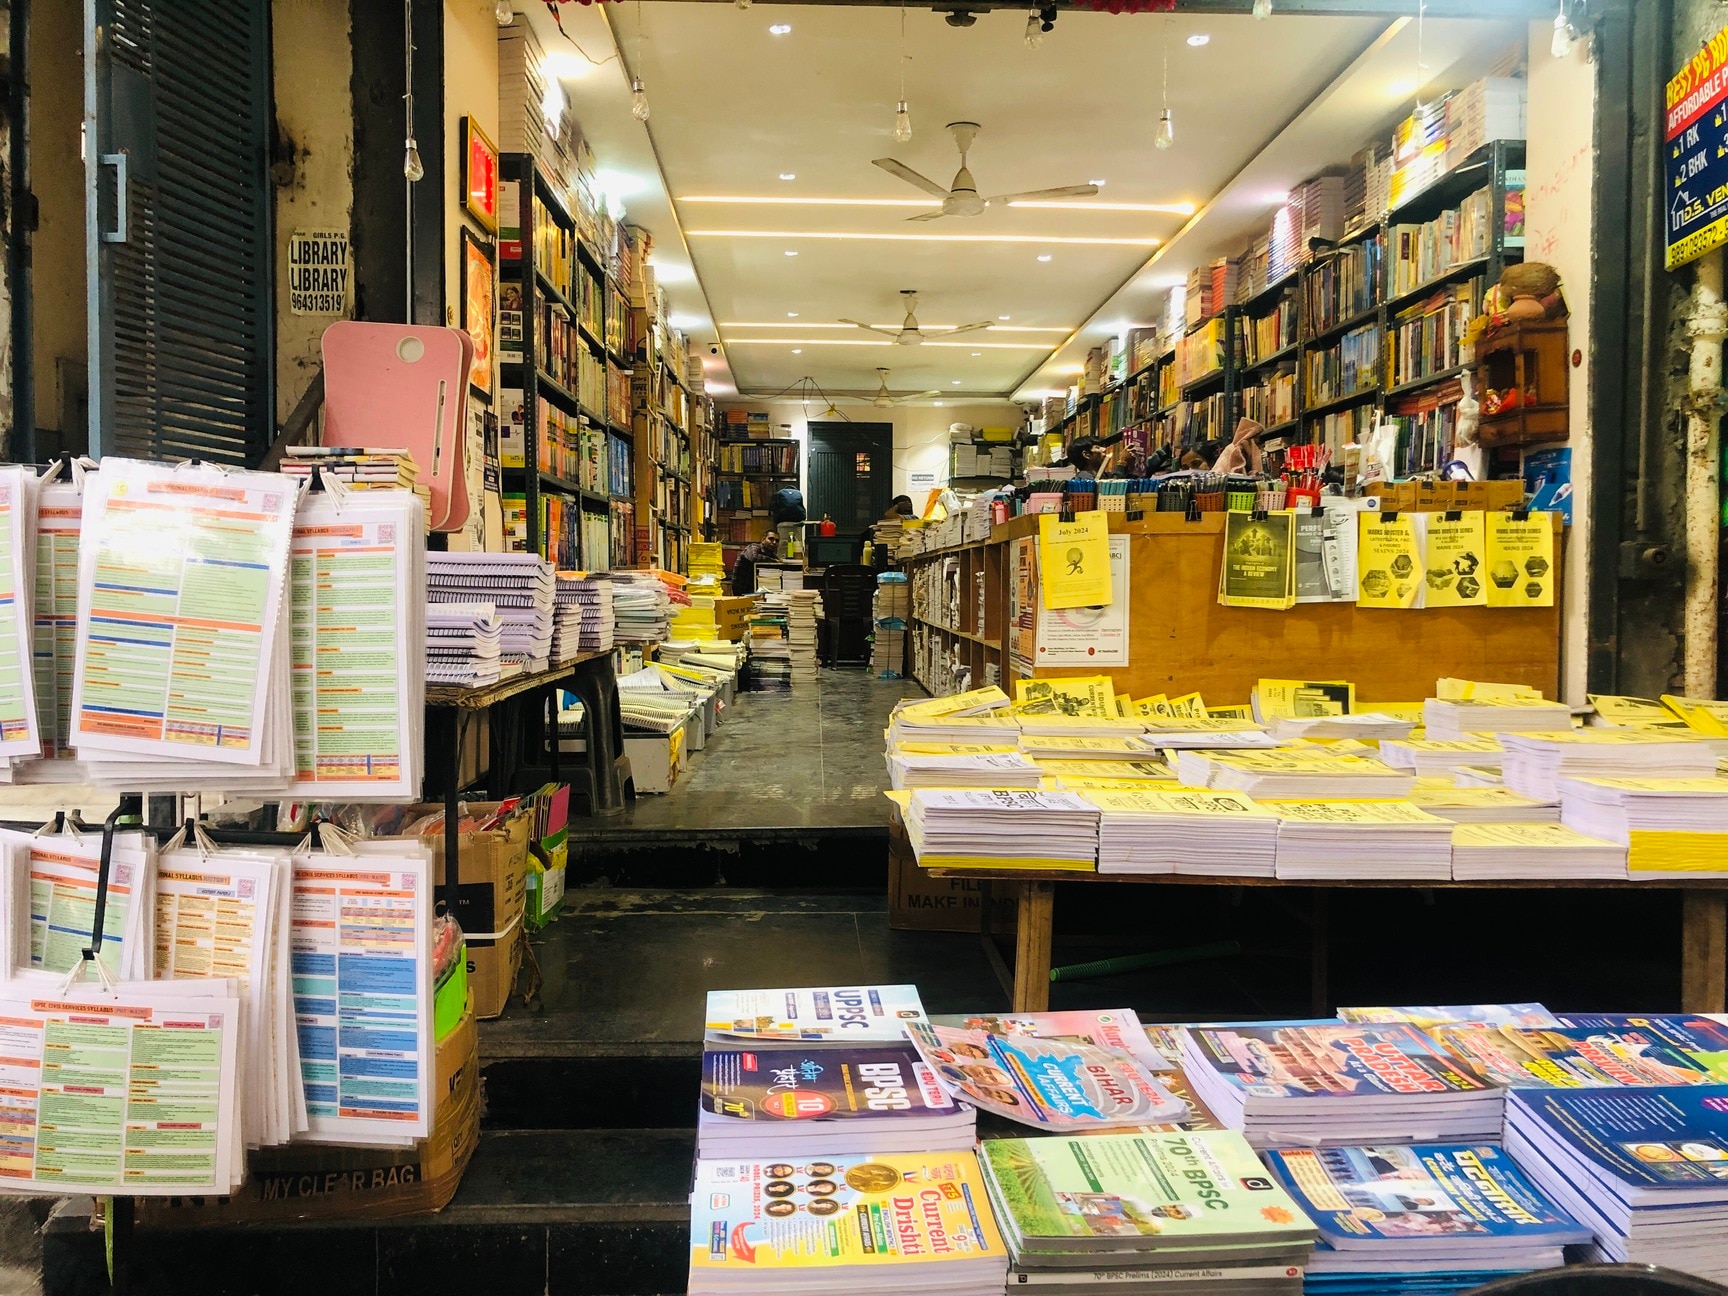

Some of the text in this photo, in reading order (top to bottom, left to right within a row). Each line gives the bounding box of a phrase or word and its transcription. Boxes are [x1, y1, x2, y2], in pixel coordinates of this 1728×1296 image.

[1666, 64, 1692, 110] BEST
[1692, 48, 1710, 87] PG
[1668, 72, 1721, 131] AFFORDABLE
[1686, 123, 1700, 149] RK
[1680, 148, 1708, 183] 2 BHK
[1705, 182, 1728, 206] VEN
[290, 240, 348, 265] LIBRARY
[290, 267, 347, 292] LIBRARY
[175, 873, 203, 881] SYLLABUS
[908, 894, 980, 908] MAKE IN
[833, 989, 870, 1029] UPPSC
[1341, 1038, 1421, 1093] PRADESH
[1374, 1042, 1447, 1093] UTTAR
[1571, 1041, 1645, 1085] PREVIEW
[795, 1096, 825, 1112] 10
[856, 1062, 911, 1112] BPSC
[921, 1071, 945, 1107] EDU TERIA
[1037, 1074, 1073, 1114] AFFAIRS
[1042, 1062, 1088, 1106] CURRENT
[1086, 1065, 1134, 1106] BIHAR
[1135, 1080, 1167, 1107] TERIA
[1146, 1138, 1180, 1176] Prelims 2024
[1161, 1137, 1231, 1210] 70th BPSC
[1188, 1136, 1214, 1160] Current
[1205, 1161, 1228, 1180] Affairs
[263, 1175, 293, 1200] MY
[371, 1164, 415, 1190] BAG
[752, 1164, 761, 1220] NOBEL PRIZES, 2024
[1452, 1150, 1544, 1225] घटनासार
[881, 1209, 892, 1229] ENGLISH
[892, 1196, 928, 1257] Drishti
[918, 1189, 951, 1255] Current
[1106, 1271, 1124, 1280] BPSC
[1124, 1270, 1150, 1280] Prelims
[1151, 1270, 1174, 1280] (2024)
[1174, 1269, 1200, 1279] Current
[1200, 1269, 1223, 1278] Affairs
